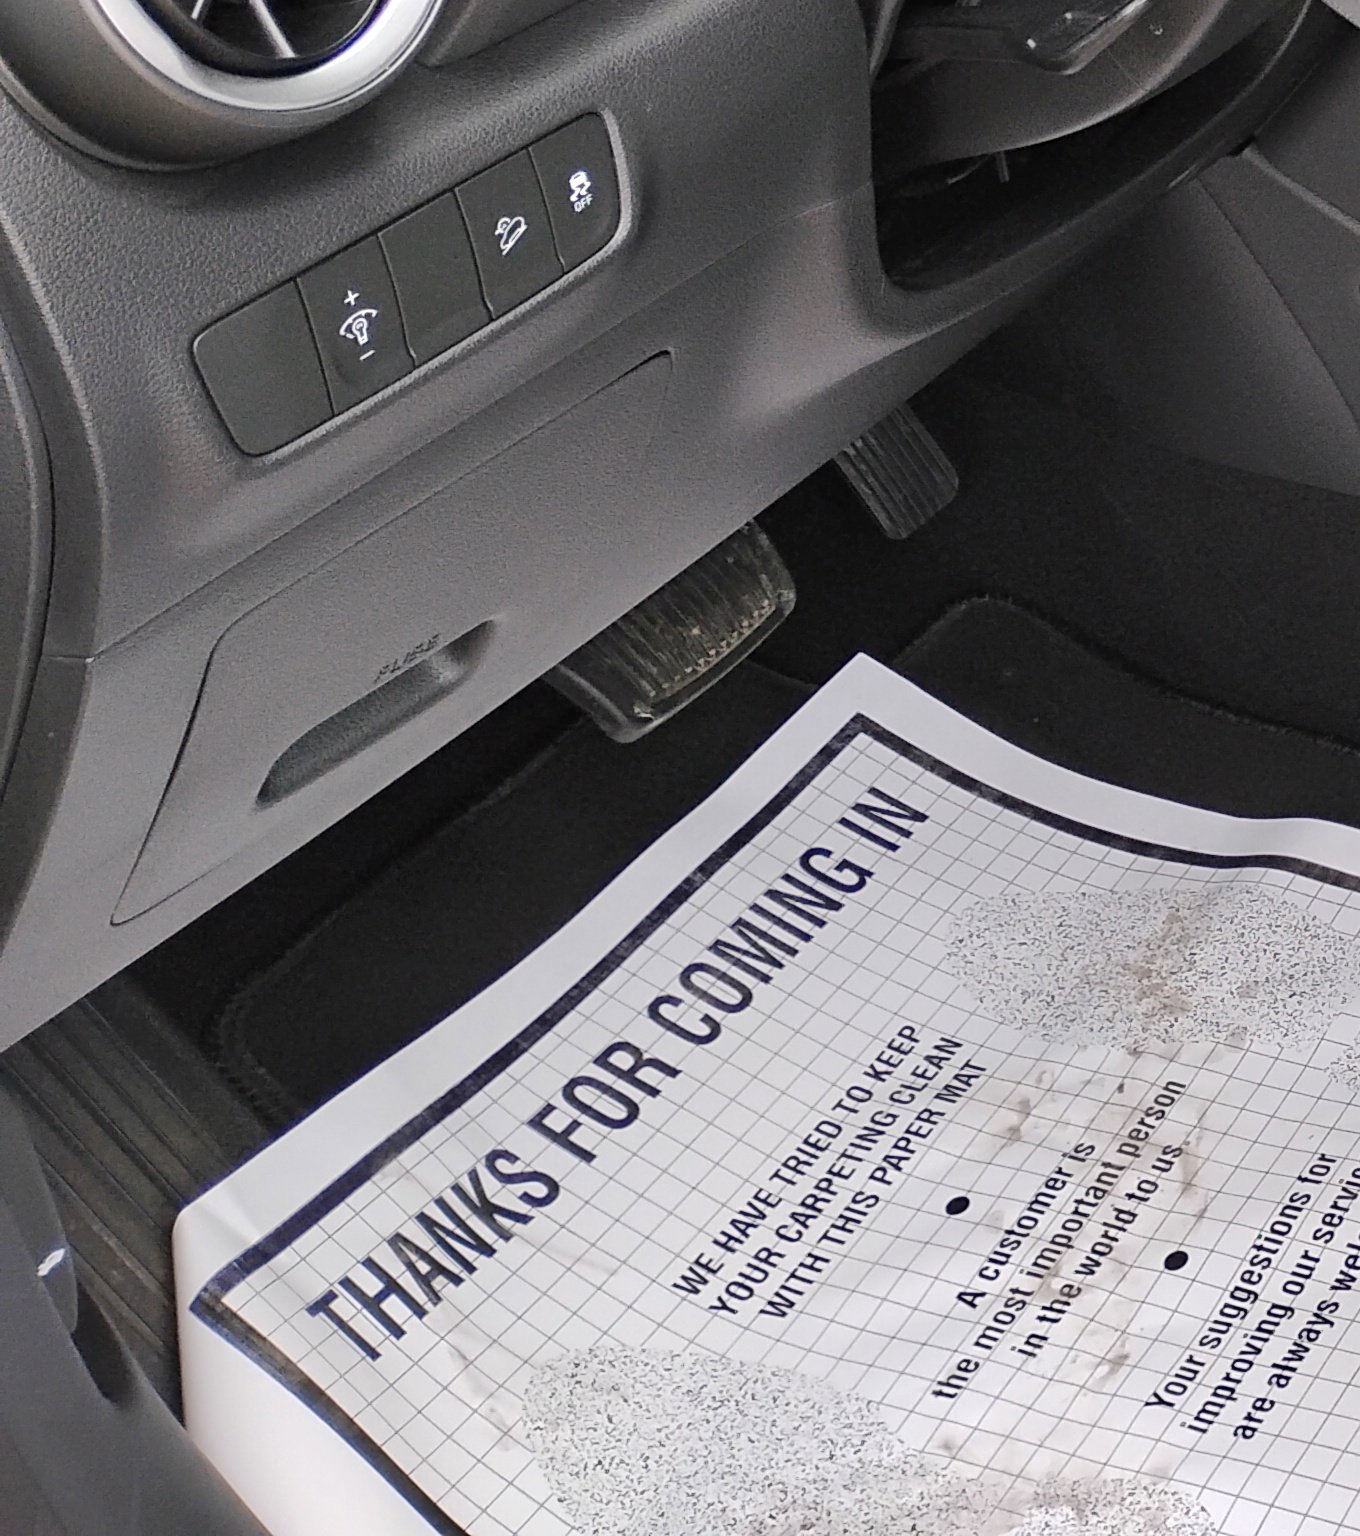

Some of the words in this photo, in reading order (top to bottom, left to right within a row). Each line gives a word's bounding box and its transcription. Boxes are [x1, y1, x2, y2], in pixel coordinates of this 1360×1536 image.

[573, 193, 593, 213] OFF
[305, 1147, 561, 1362] THANKS
[526, 1040, 684, 1165] FOR
[647, 846, 875, 1046] COMING
[838, 786, 930, 853] IN
[672, 1253, 725, 1296] WE
[712, 1188, 783, 1254] HAVE
[769, 1119, 844, 1187] TRIED
[832, 1085, 874, 1114] TO
[863, 1024, 921, 1083] KEEP
[709, 1246, 786, 1315] YOUR
[775, 1109, 900, 1243] CARPETING
[889, 1036, 964, 1105] CLEAN
[759, 1252, 831, 1319] WITH
[818, 1190, 881, 1246] THIS
[868, 1107, 947, 1187] PAPER
[934, 1058, 988, 1104] MAT
[931, 1358, 980, 1400] the
[973, 1286, 1035, 1350] most
[1019, 1161, 1126, 1279] important
[1116, 1079, 1187, 1159] person
[956, 1288, 987, 1309] A
[978, 1166, 1074, 1282] customer
[1062, 1142, 1096, 1163] is
[1010, 1332, 1050, 1358] in
[1036, 1282, 1083, 1325] the
[1074, 1203, 1140, 1278] world
[1125, 1178, 1160, 1204] to
[1144, 1354, 1205, 1409] Your
[1199, 1191, 1311, 1350] suggestions
[1297, 1153, 1338, 1185] for
[1180, 1302, 1295, 1434] improving
[1282, 1249, 1321, 1296] our
[1233, 1396, 1276, 1440] are
[1267, 1299, 1340, 1389] always
